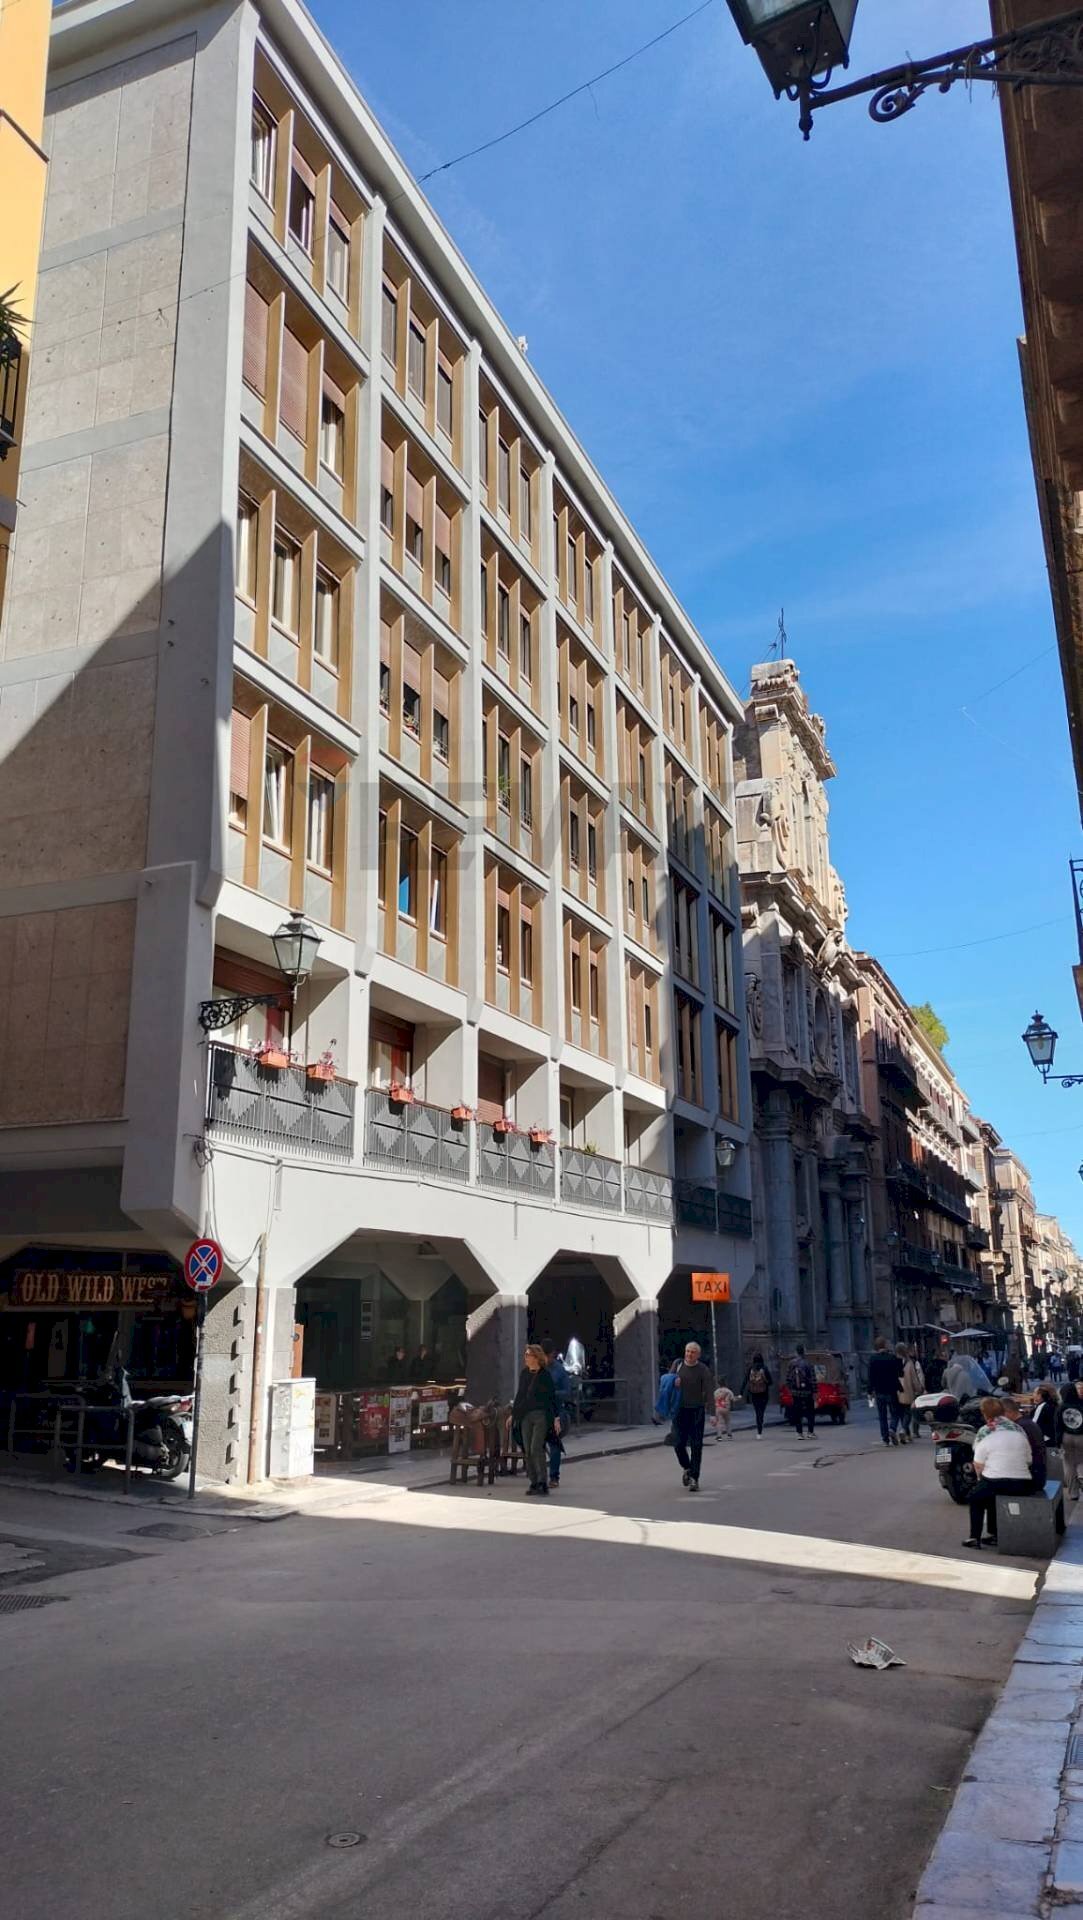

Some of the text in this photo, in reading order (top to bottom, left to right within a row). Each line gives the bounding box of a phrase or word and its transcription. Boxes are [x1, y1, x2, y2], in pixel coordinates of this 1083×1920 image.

[21, 1273, 60, 1304] OLD
[67, 1275, 115, 1304] WILD
[695, 1280, 728, 1293] TAXI
